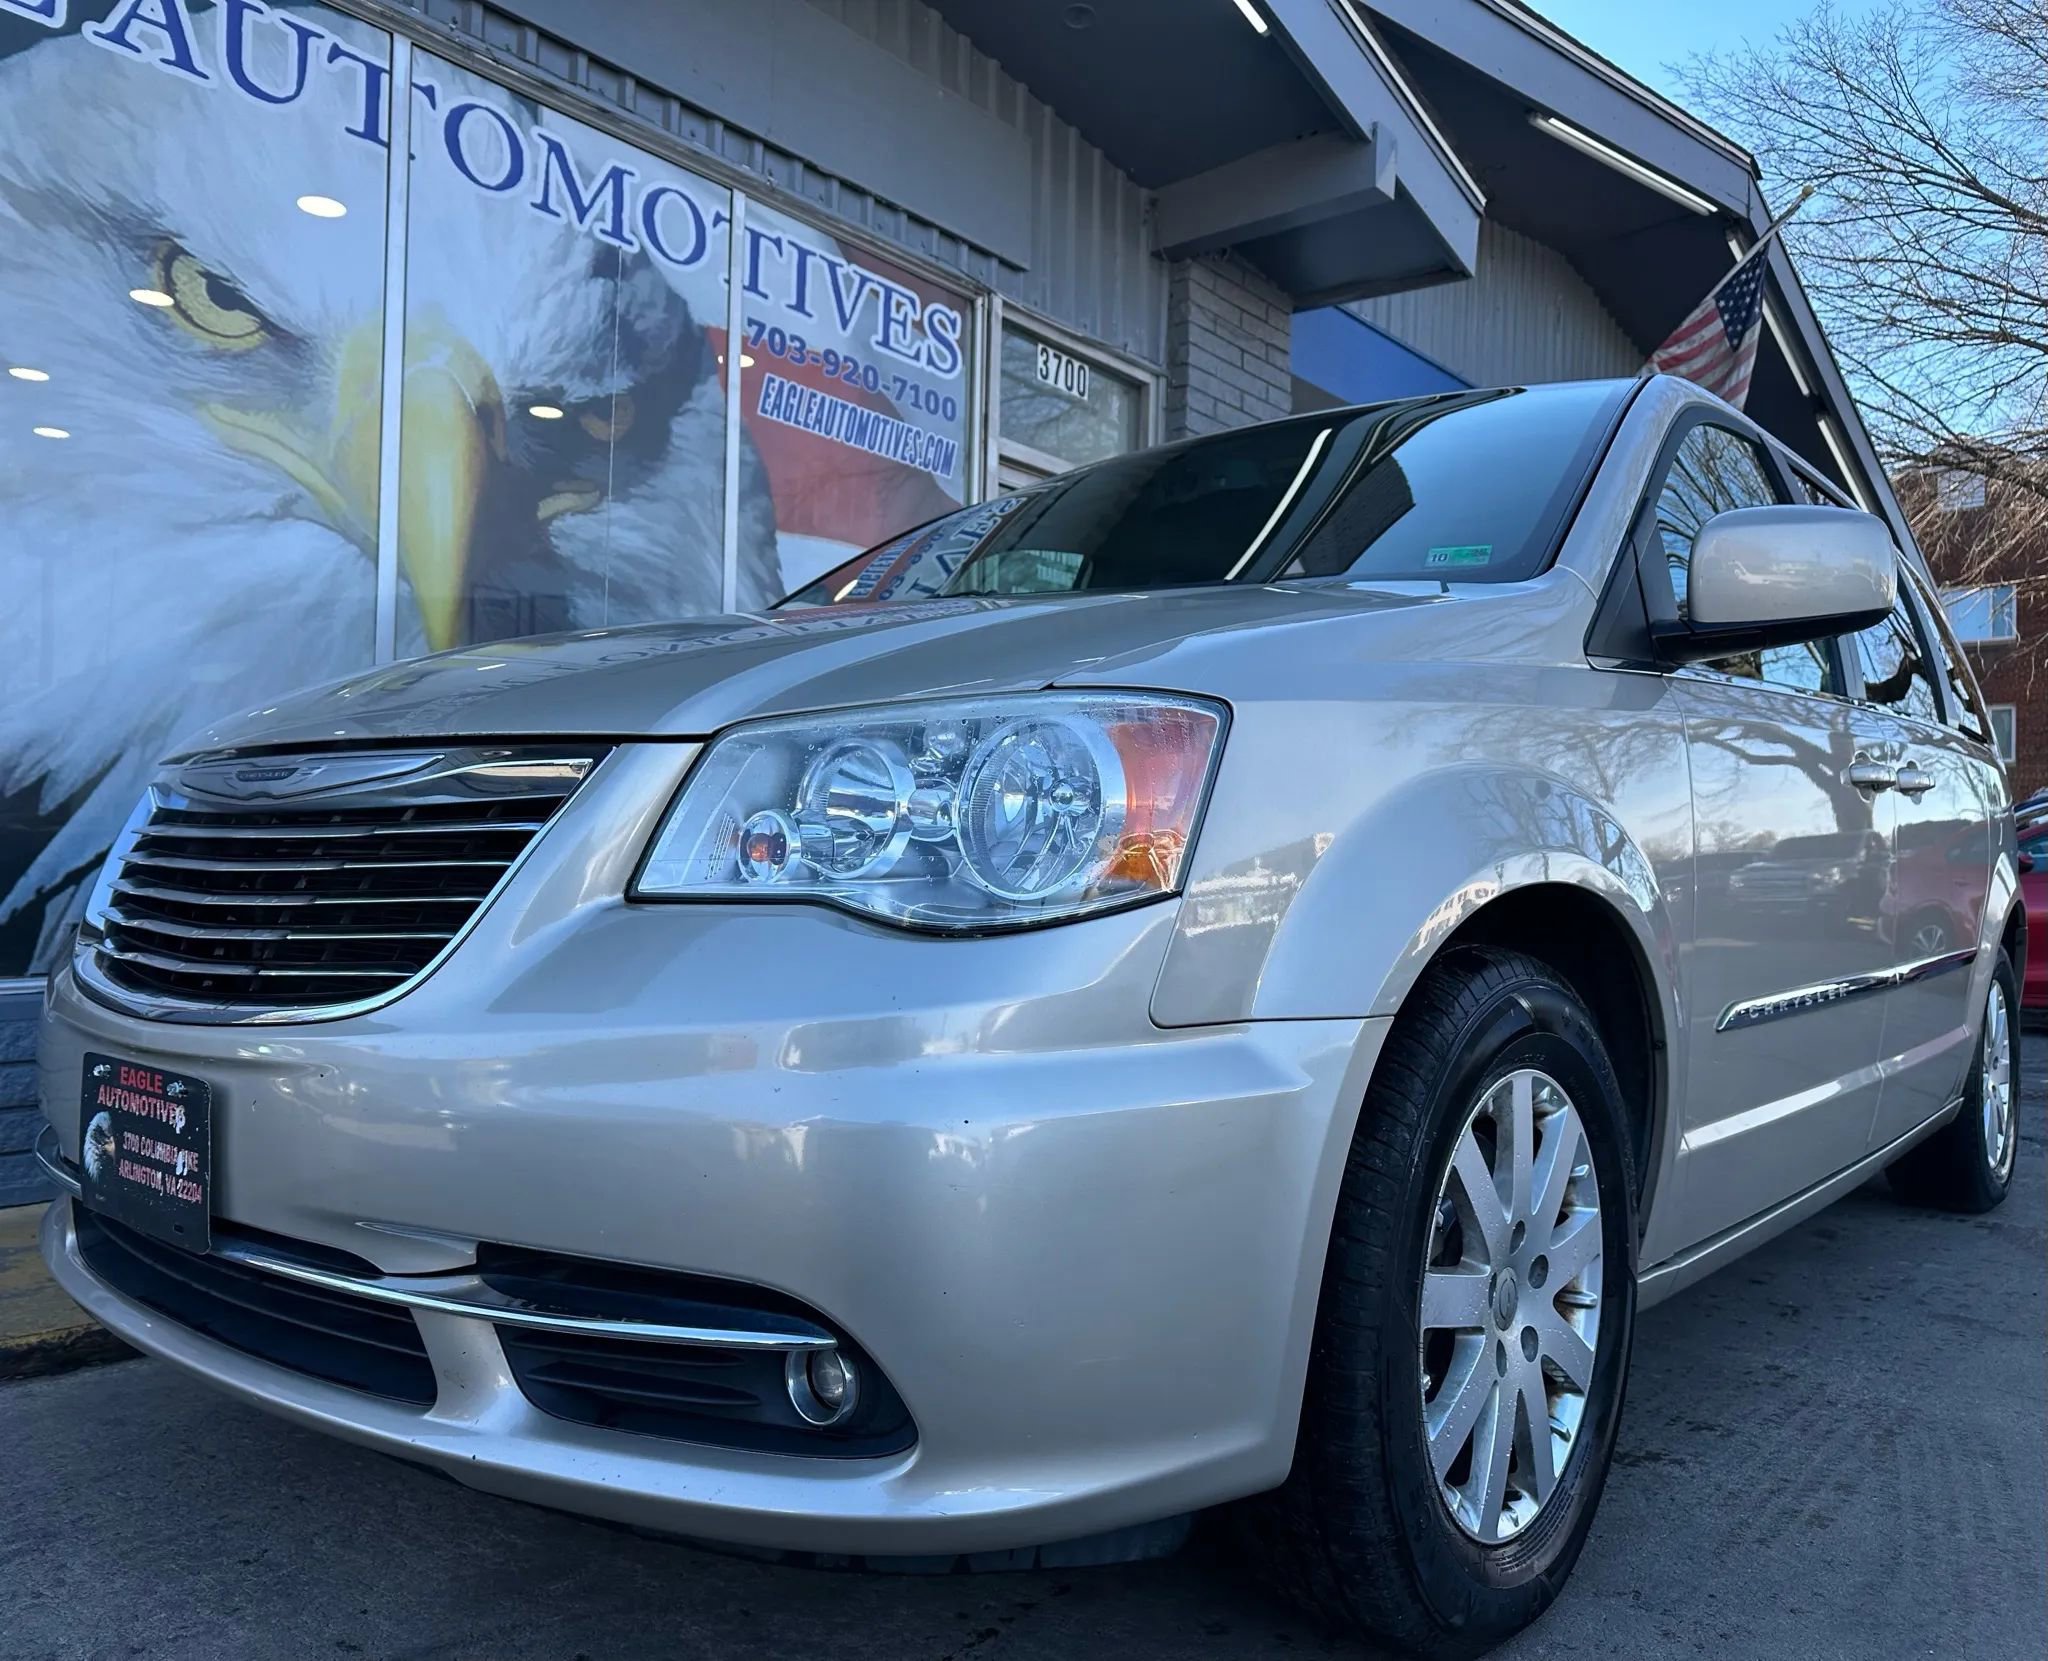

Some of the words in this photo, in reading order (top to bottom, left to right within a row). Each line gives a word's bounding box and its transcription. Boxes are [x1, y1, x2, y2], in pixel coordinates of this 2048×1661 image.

[88, 0, 963, 376] AUTOMOTIVES
[746, 316, 958, 422] 703-920-7100
[1039, 346, 1087, 398] 3700
[758, 373, 958, 478] EAGLEAUTOMOTIVES.COM
[1749, 985, 1847, 1018] CHRYSLER
[120, 1066, 163, 1094] EAGLE
[165, 1174, 177, 1196] VA
